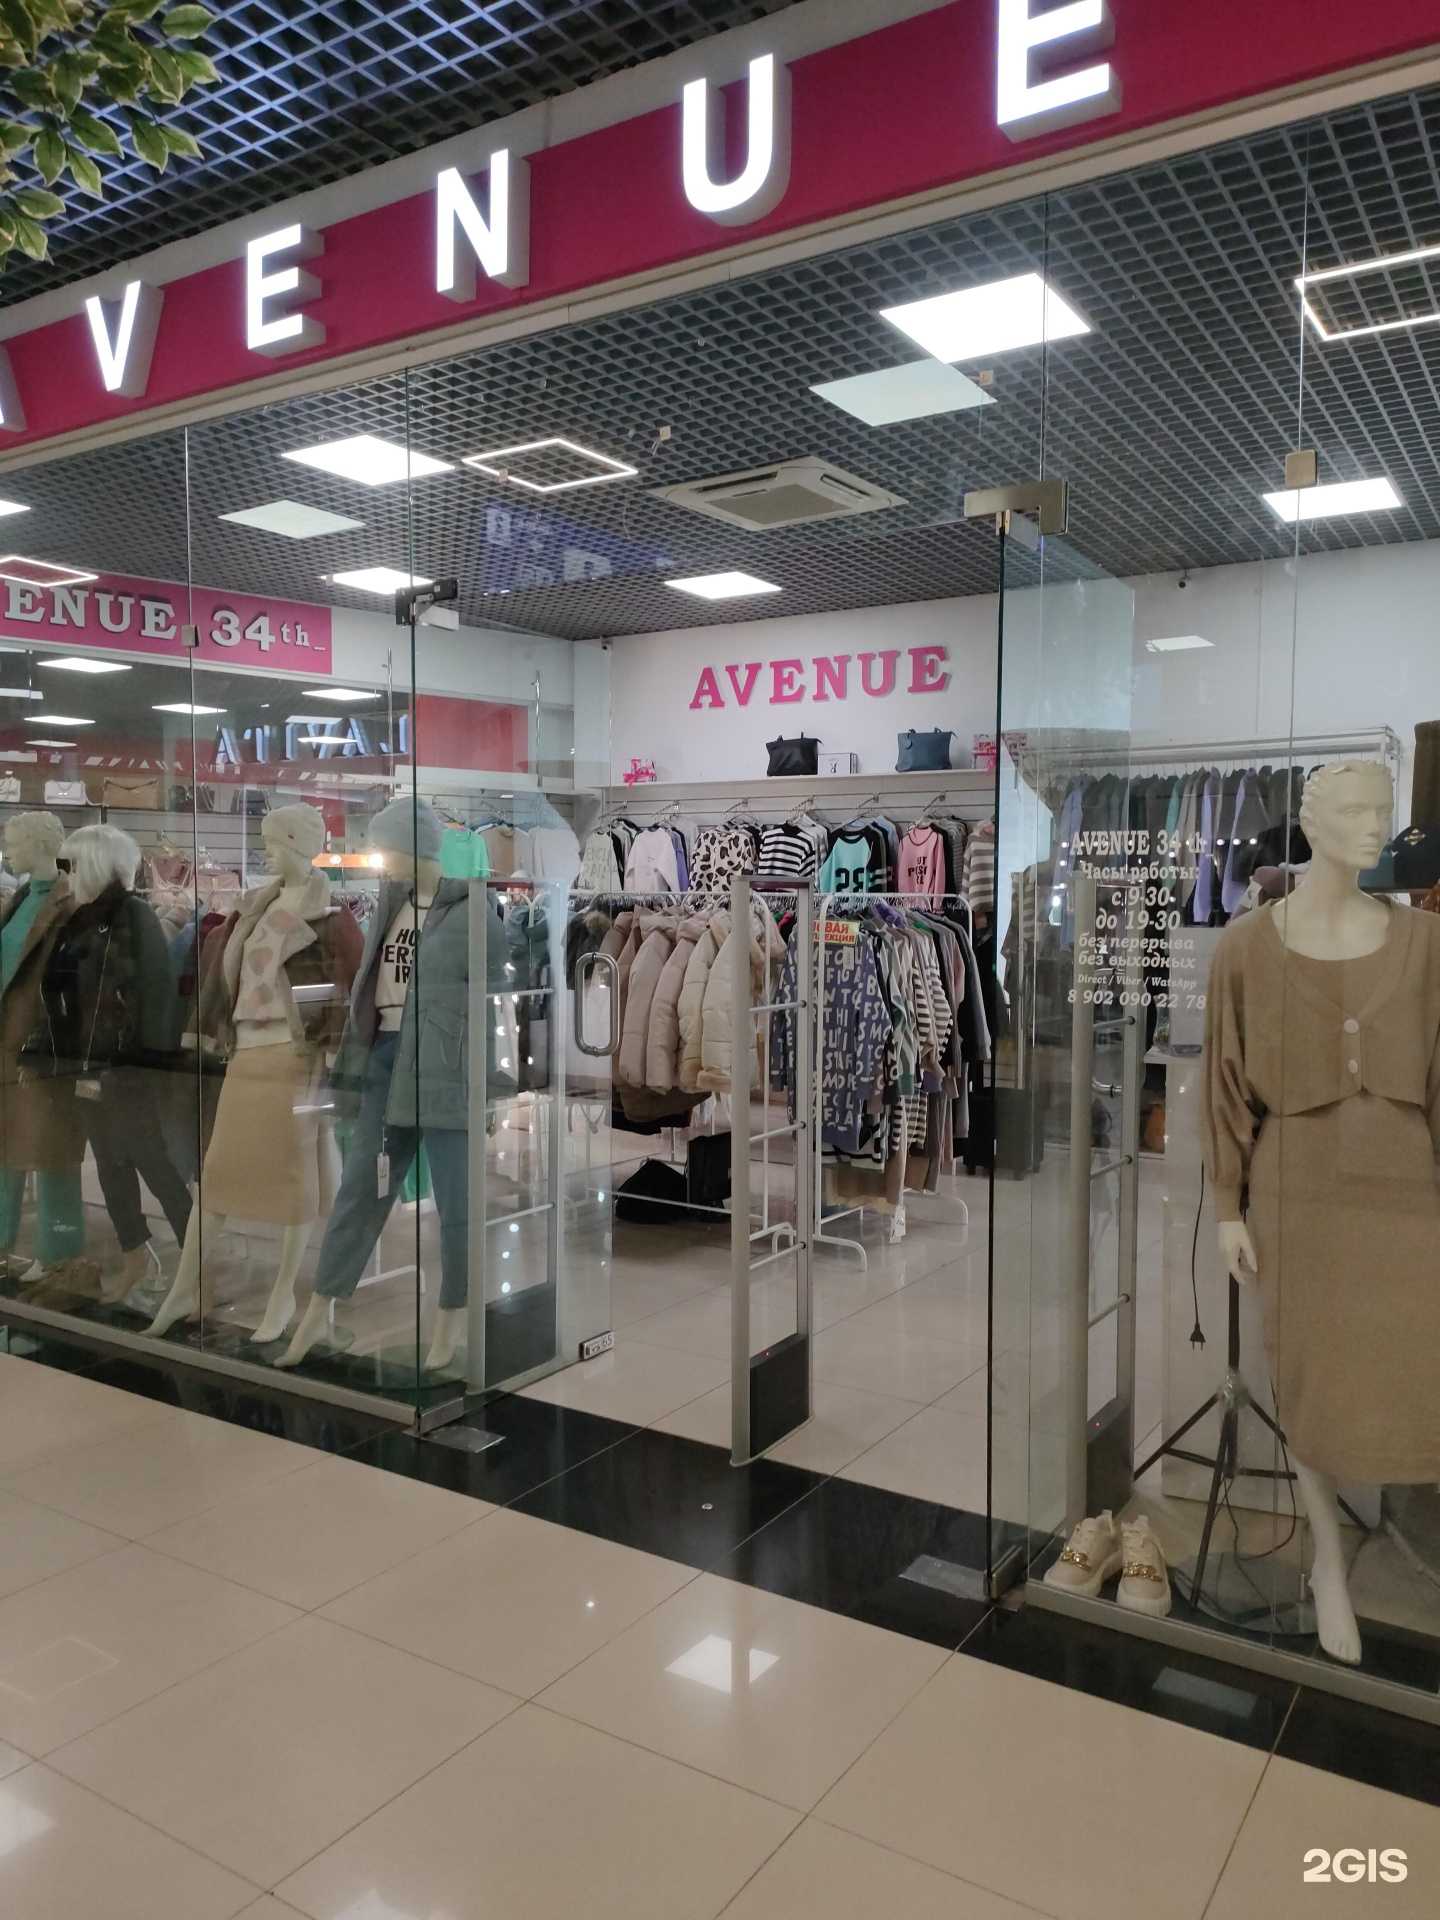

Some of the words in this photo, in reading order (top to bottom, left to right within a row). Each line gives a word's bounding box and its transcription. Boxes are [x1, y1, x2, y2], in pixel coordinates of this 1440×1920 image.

[0, 0, 1112, 425] VENUE
[4, 579, 177, 641] ENUE
[689, 646, 950, 709] AVENUE
[1070, 830, 1150, 855] AVENUE
[1156, 830, 1181, 855] 34
[1080, 860, 1125, 879] Часы
[1128, 861, 1200, 884] работы:
[1095, 907, 1118, 930] до
[1124, 910, 1181, 931] 19-30
[1110, 936, 1195, 953] перерыва
[1077, 950, 1105, 966] без
[1108, 951, 1196, 969] выходных
[1067, 989, 1077, 1004] 8
[1083, 990, 1114, 1005] 902
[1119, 991, 1152, 1007] 090
[1155, 992, 1179, 1009] 22
[1186, 994, 1208, 1010] 78
